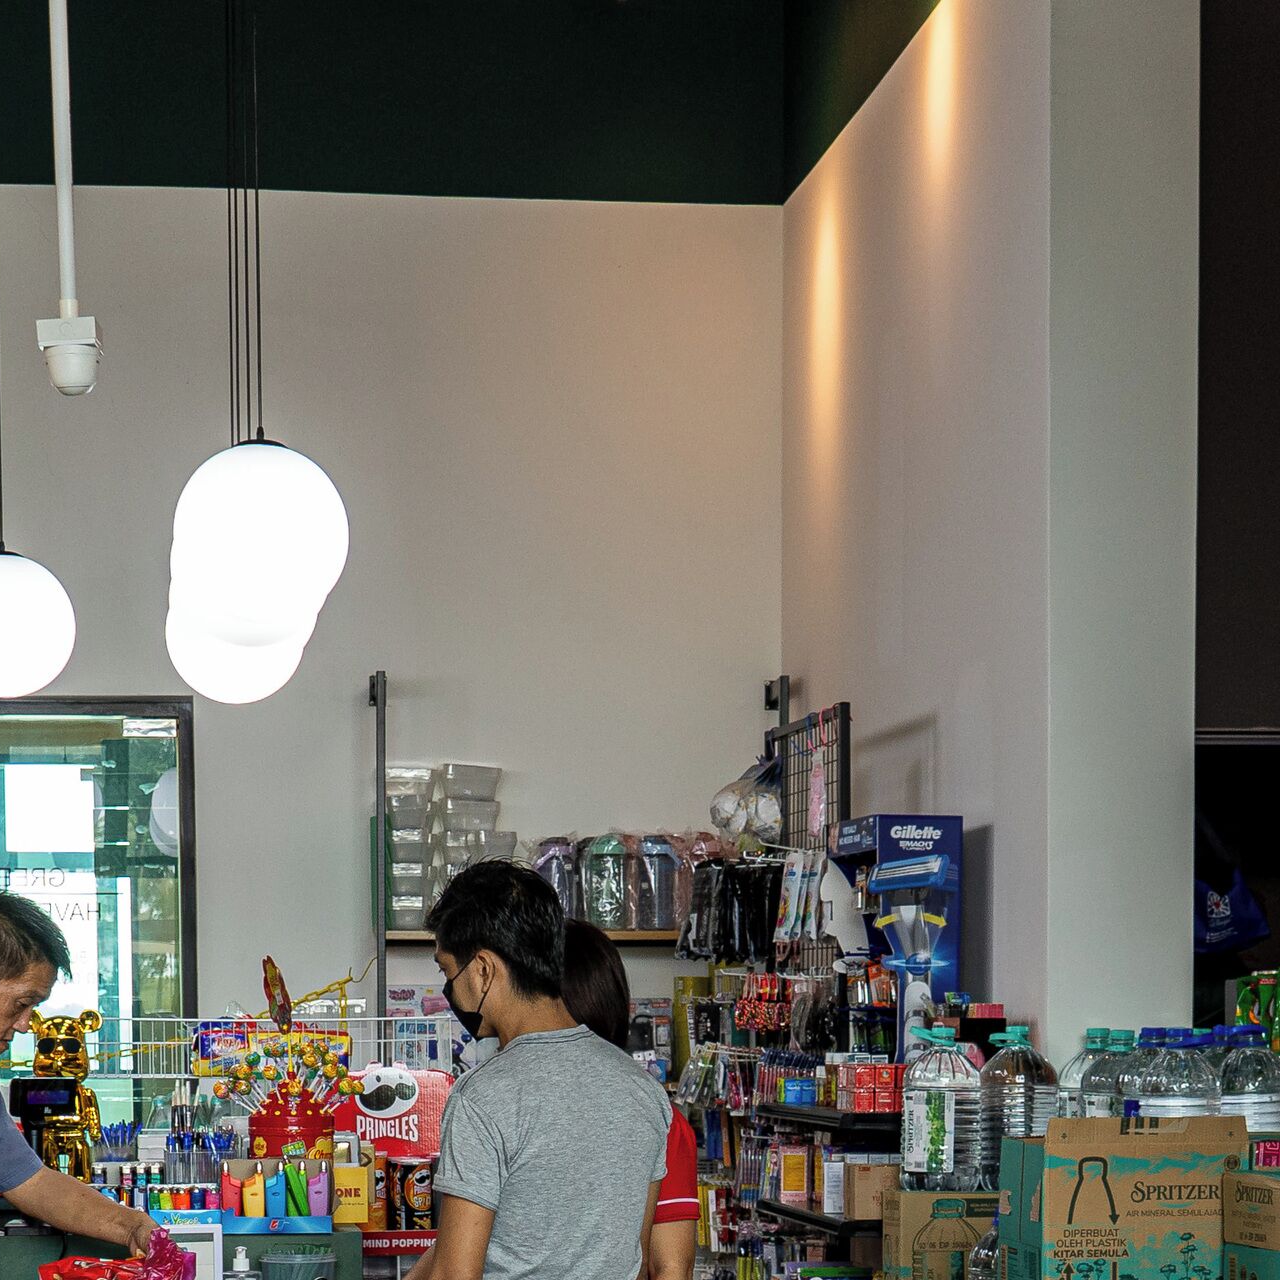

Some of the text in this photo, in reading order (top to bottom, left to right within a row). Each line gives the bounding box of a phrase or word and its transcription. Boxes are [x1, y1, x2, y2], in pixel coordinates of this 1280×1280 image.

[891, 825, 942, 839] Gillette
[356, 1114, 419, 1142] PRINGLES
[1131, 1181, 1220, 1203] SPRITZER
[1235, 1181, 1273, 1205] SPRITZER
[1141, 1209, 1176, 1217] MINERAL
[1063, 1229, 1119, 1238] DIPERBUAT
[363, 1238, 390, 1248] MIND
[1056, 1238, 1127, 1248] OLEH PLASTIK
[1053, 1250, 1129, 1258] KITAR SEMULA
